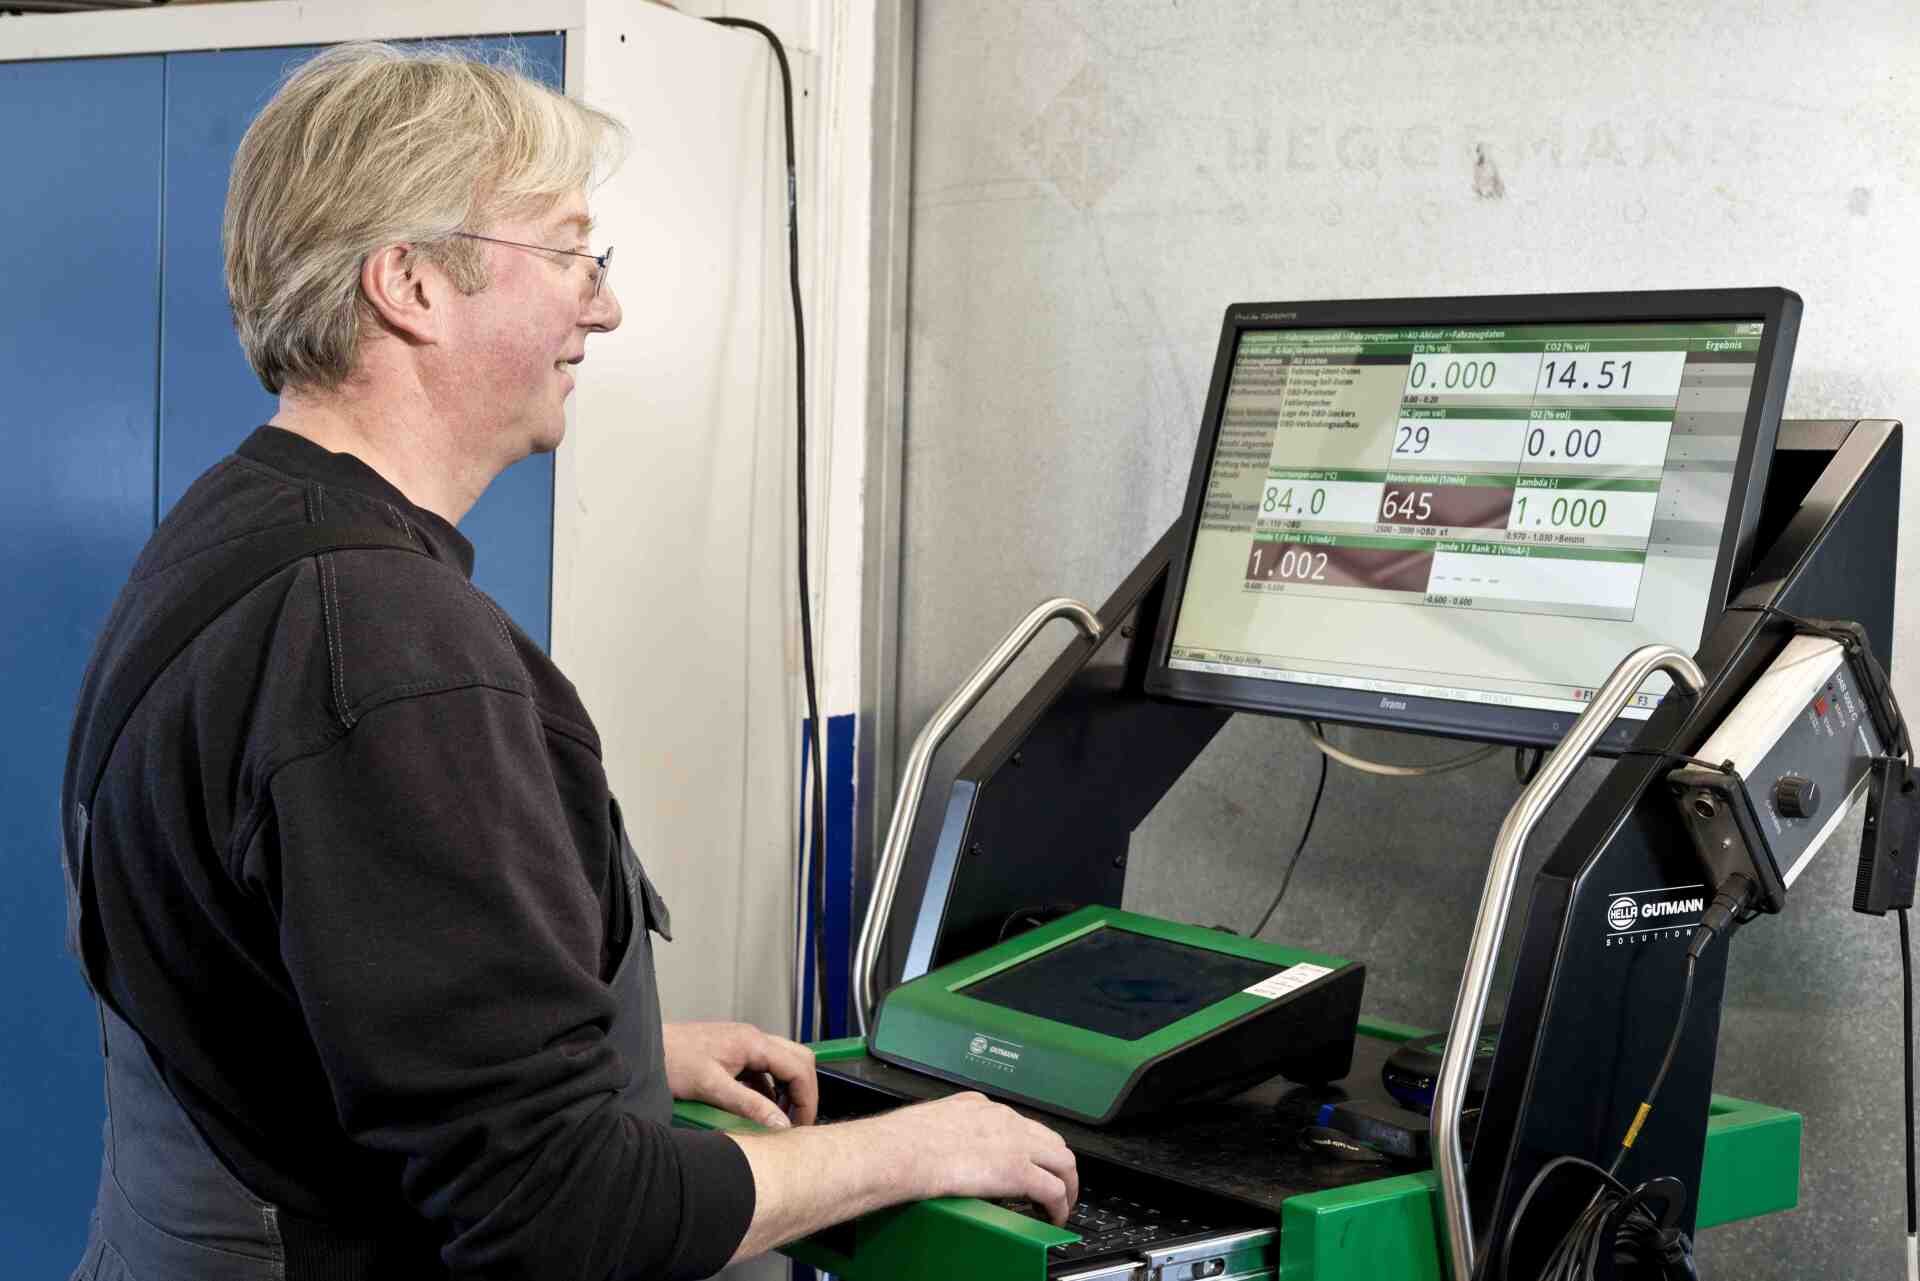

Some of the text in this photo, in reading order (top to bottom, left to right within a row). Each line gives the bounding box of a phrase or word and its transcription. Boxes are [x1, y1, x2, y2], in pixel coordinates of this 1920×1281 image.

[1545, 342, 1562, 351] CO2
[1705, 340, 1742, 352] Ergebnis
[1410, 361, 1496, 388] 0.000
[1545, 360, 1632, 389] 14.51
[1396, 426, 1430, 453] 29
[1528, 428, 1602, 457] 0.00
[1516, 478, 1548, 488] Lambda
[1263, 487, 1326, 515] 84.0
[1382, 490, 1433, 520] 645
[1518, 497, 1607, 528] 1.000
[1253, 549, 1328, 580] 1.002
[1583, 690, 1593, 700] F1
[1638, 695, 1649, 707] F3
[1641, 898, 1704, 918] GUTMANN
[1606, 928, 1692, 947] SOLUTION
